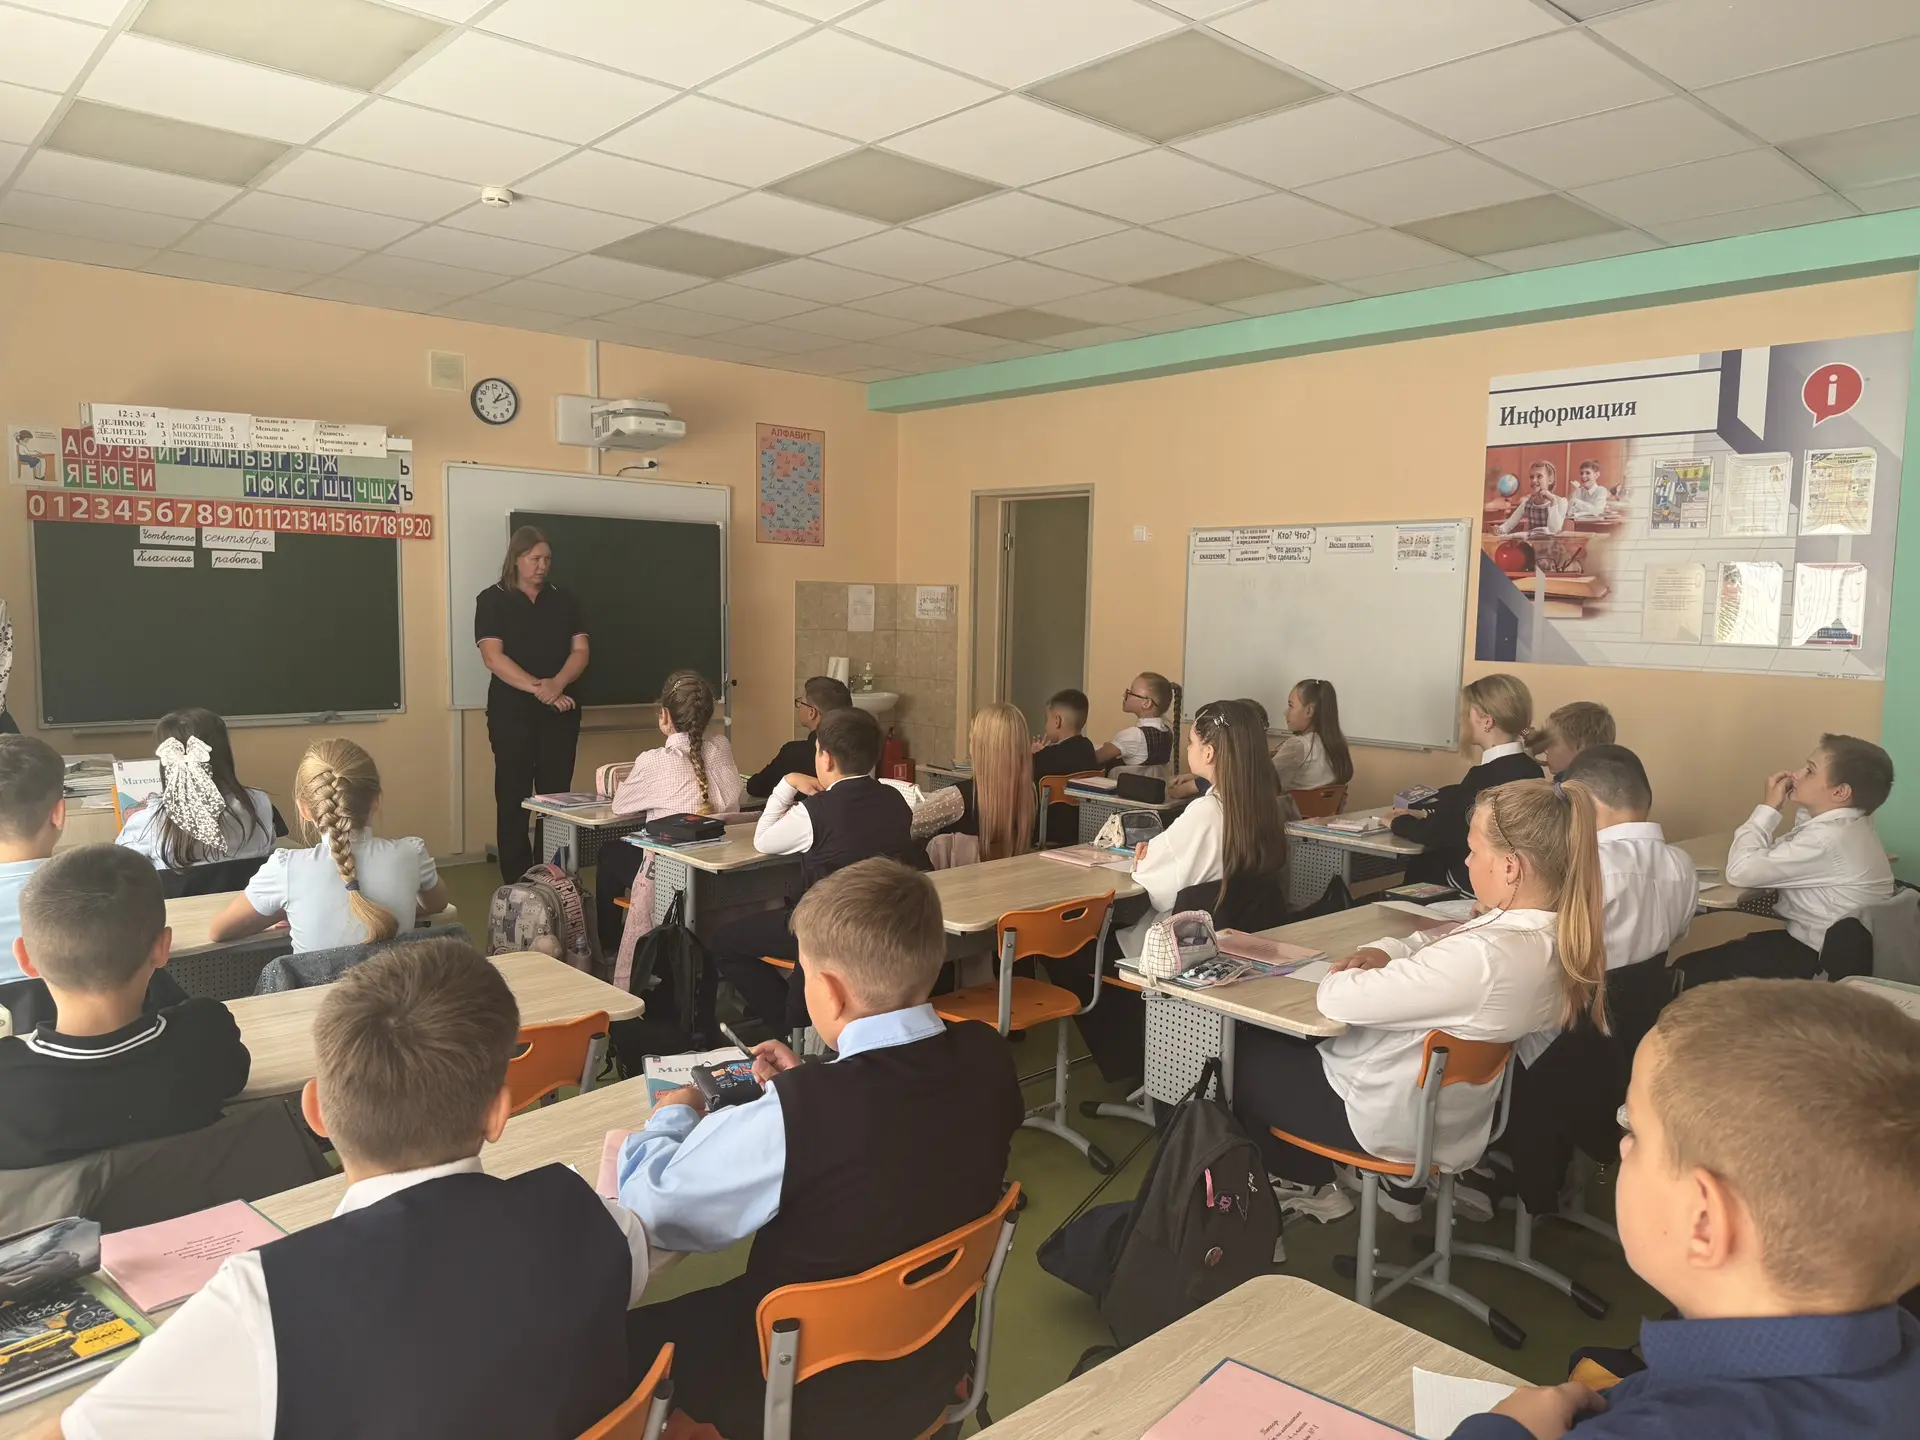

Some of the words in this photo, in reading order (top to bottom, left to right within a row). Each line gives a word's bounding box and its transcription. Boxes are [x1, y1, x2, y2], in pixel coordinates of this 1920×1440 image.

[118, 410, 128, 418] 12
[1499, 401, 1637, 428] Информация
[98, 418, 146, 428] ДЕЛИМОЕ
[172, 422, 223, 432] МНОЖИТЕЛЬ
[97, 427, 147, 436] ДЕЛИТЕЛЬ
[172, 431, 224, 439] МНОЖИТЕЛЬ
[771, 428, 812, 440] АЛФАВИТ
[64, 435, 79, 455] А
[102, 436, 147, 445] ЧАСТНОЕ
[173, 439, 239, 449] ПРОИЗВЕДЕНИЕ
[66, 463, 79, 484] Я
[85, 460, 98, 486] Ё
[102, 465, 118, 485] Ю
[123, 467, 135, 486] Е
[140, 468, 153, 487] И
[261, 476, 274, 494] Ф
[29, 495, 45, 516] 0
[53, 496, 64, 518] 1
[72, 497, 89, 519] 2
[94, 498, 110, 520] 3
[114, 499, 132, 521] 4
[136, 500, 152, 522] 5
[156, 501, 173, 523] 6
[177, 503, 193, 524] 7
[197, 503, 214, 525] 8
[217, 505, 233, 526] 9
[235, 507, 253, 527] 10
[255, 508, 272, 529] 11
[273, 509, 291, 530] 12
[292, 510, 309, 530] 13
[310, 511, 327, 531] 14
[328, 513, 345, 532] 15
[346, 514, 362, 533] 16
[364, 515, 379, 535] 17
[380, 516, 396, 535] 18
[399, 517, 413, 536] 19
[415, 518, 431, 537] 20
[142, 528, 195, 545] Четвертое
[204, 529, 272, 549] сентября.
[1277, 530, 1292, 539] Кто?
[1294, 530, 1311, 539] Что?
[137, 550, 192, 563] Классная
[213, 552, 261, 567] работа.
